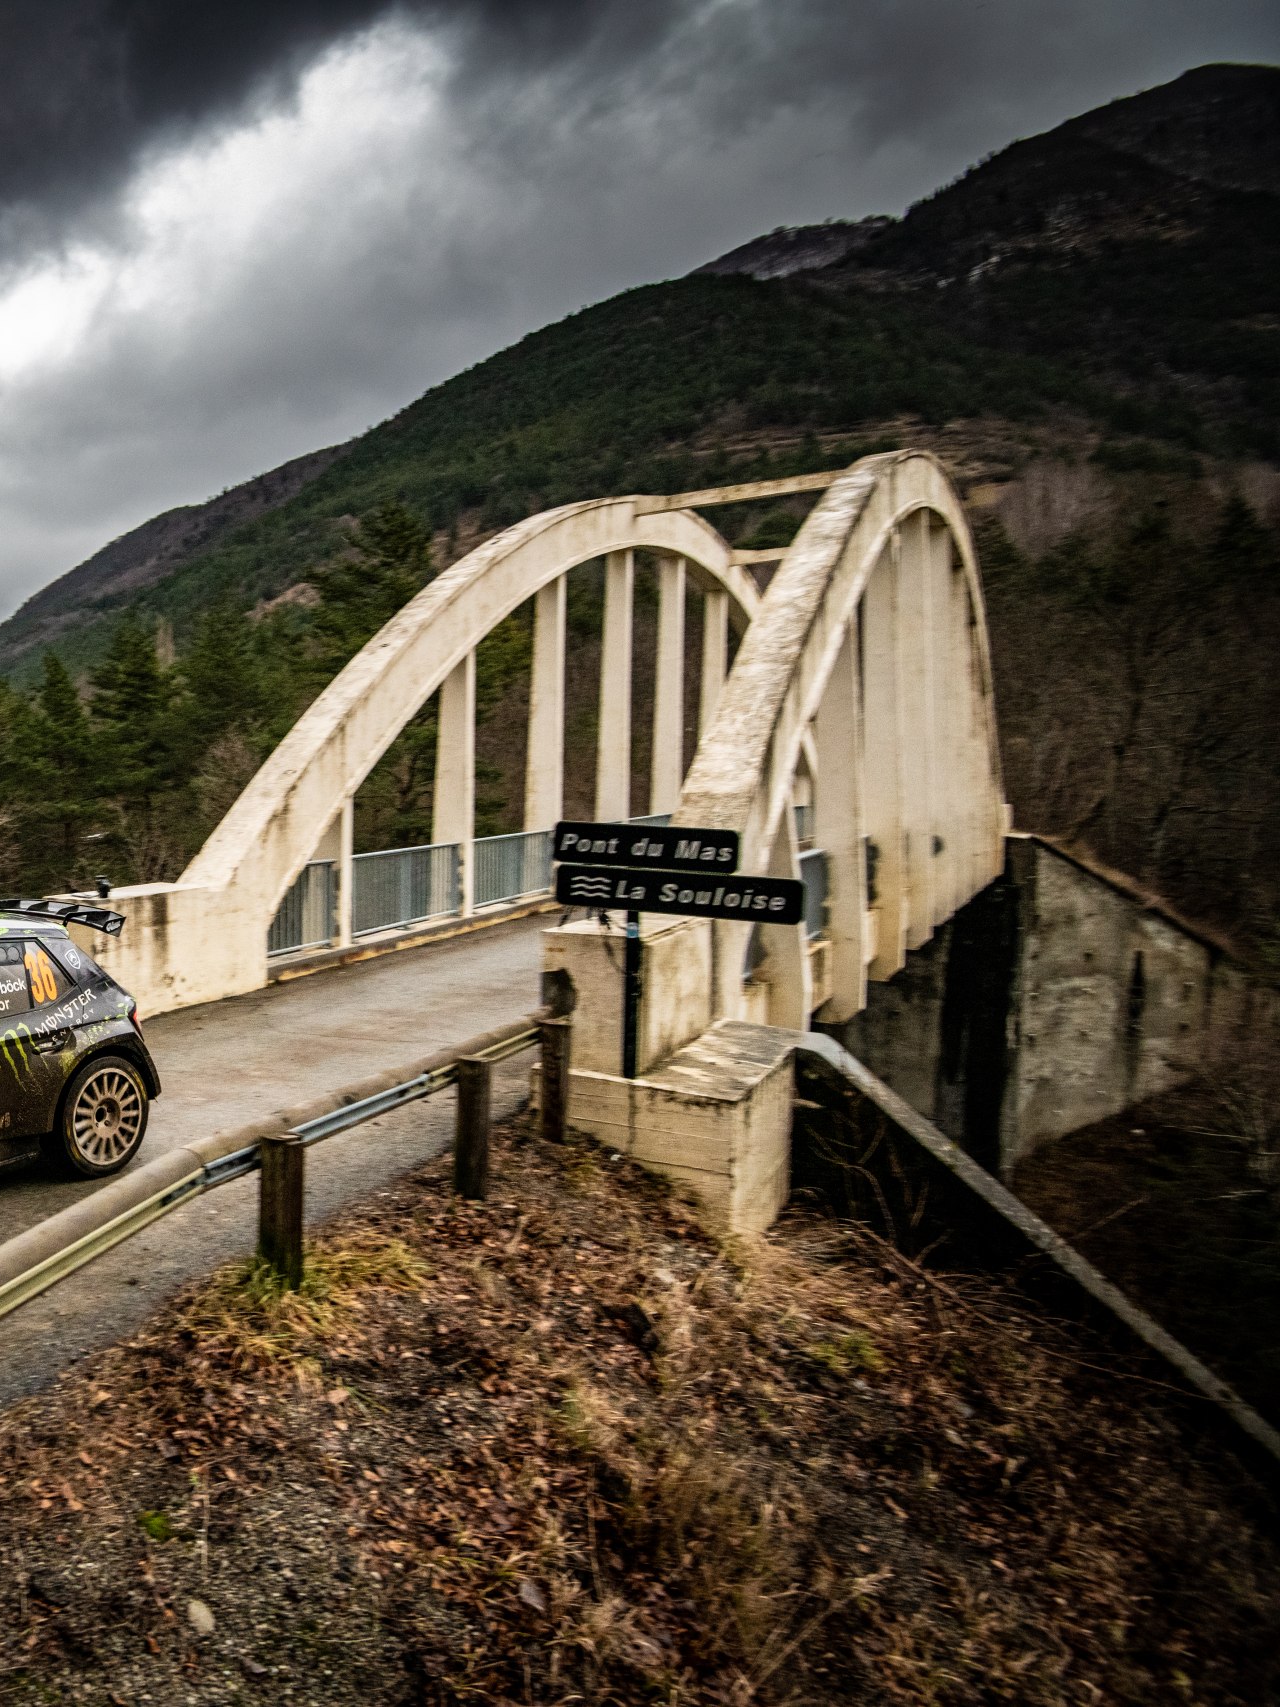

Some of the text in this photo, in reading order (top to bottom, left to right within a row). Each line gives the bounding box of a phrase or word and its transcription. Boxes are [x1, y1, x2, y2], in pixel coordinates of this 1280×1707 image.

[560, 833, 733, 862] Pont du Mas
[615, 880, 786, 911] La Souloise
[24, 949, 58, 1004] 36
